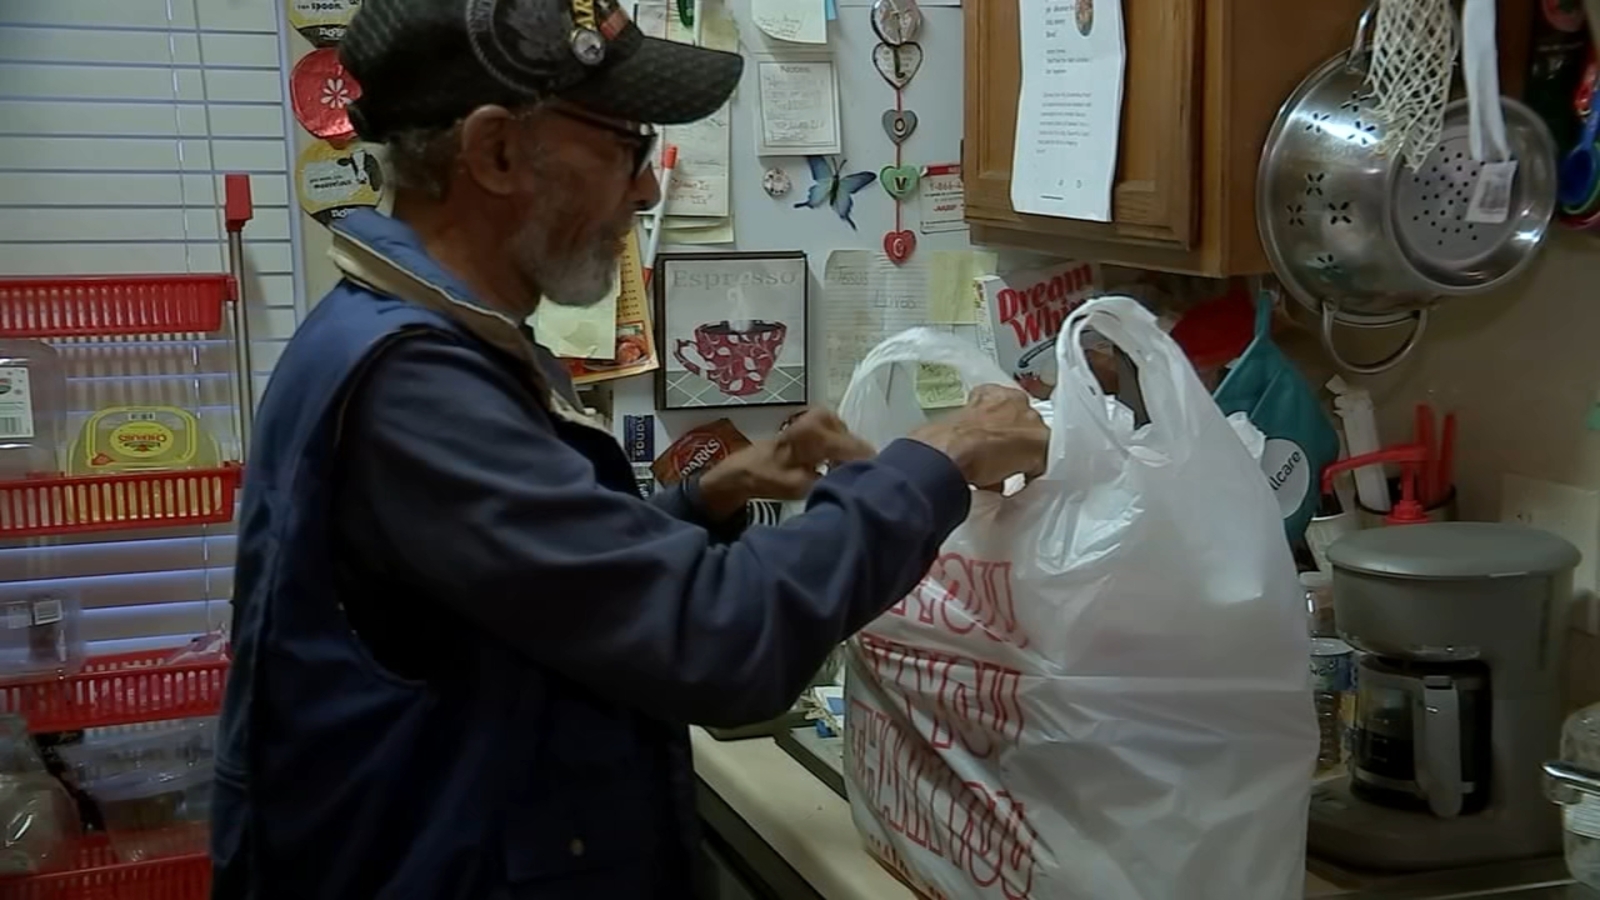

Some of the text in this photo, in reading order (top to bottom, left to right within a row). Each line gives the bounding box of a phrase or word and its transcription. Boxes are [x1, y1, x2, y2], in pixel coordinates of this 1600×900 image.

[311, 2, 344, 12] spoon.
[673, 268, 797, 291] Espresso
[996, 262, 1093, 325] Dream
[1009, 296, 1080, 349] Whi
[1268, 451, 1301, 491] llcare
